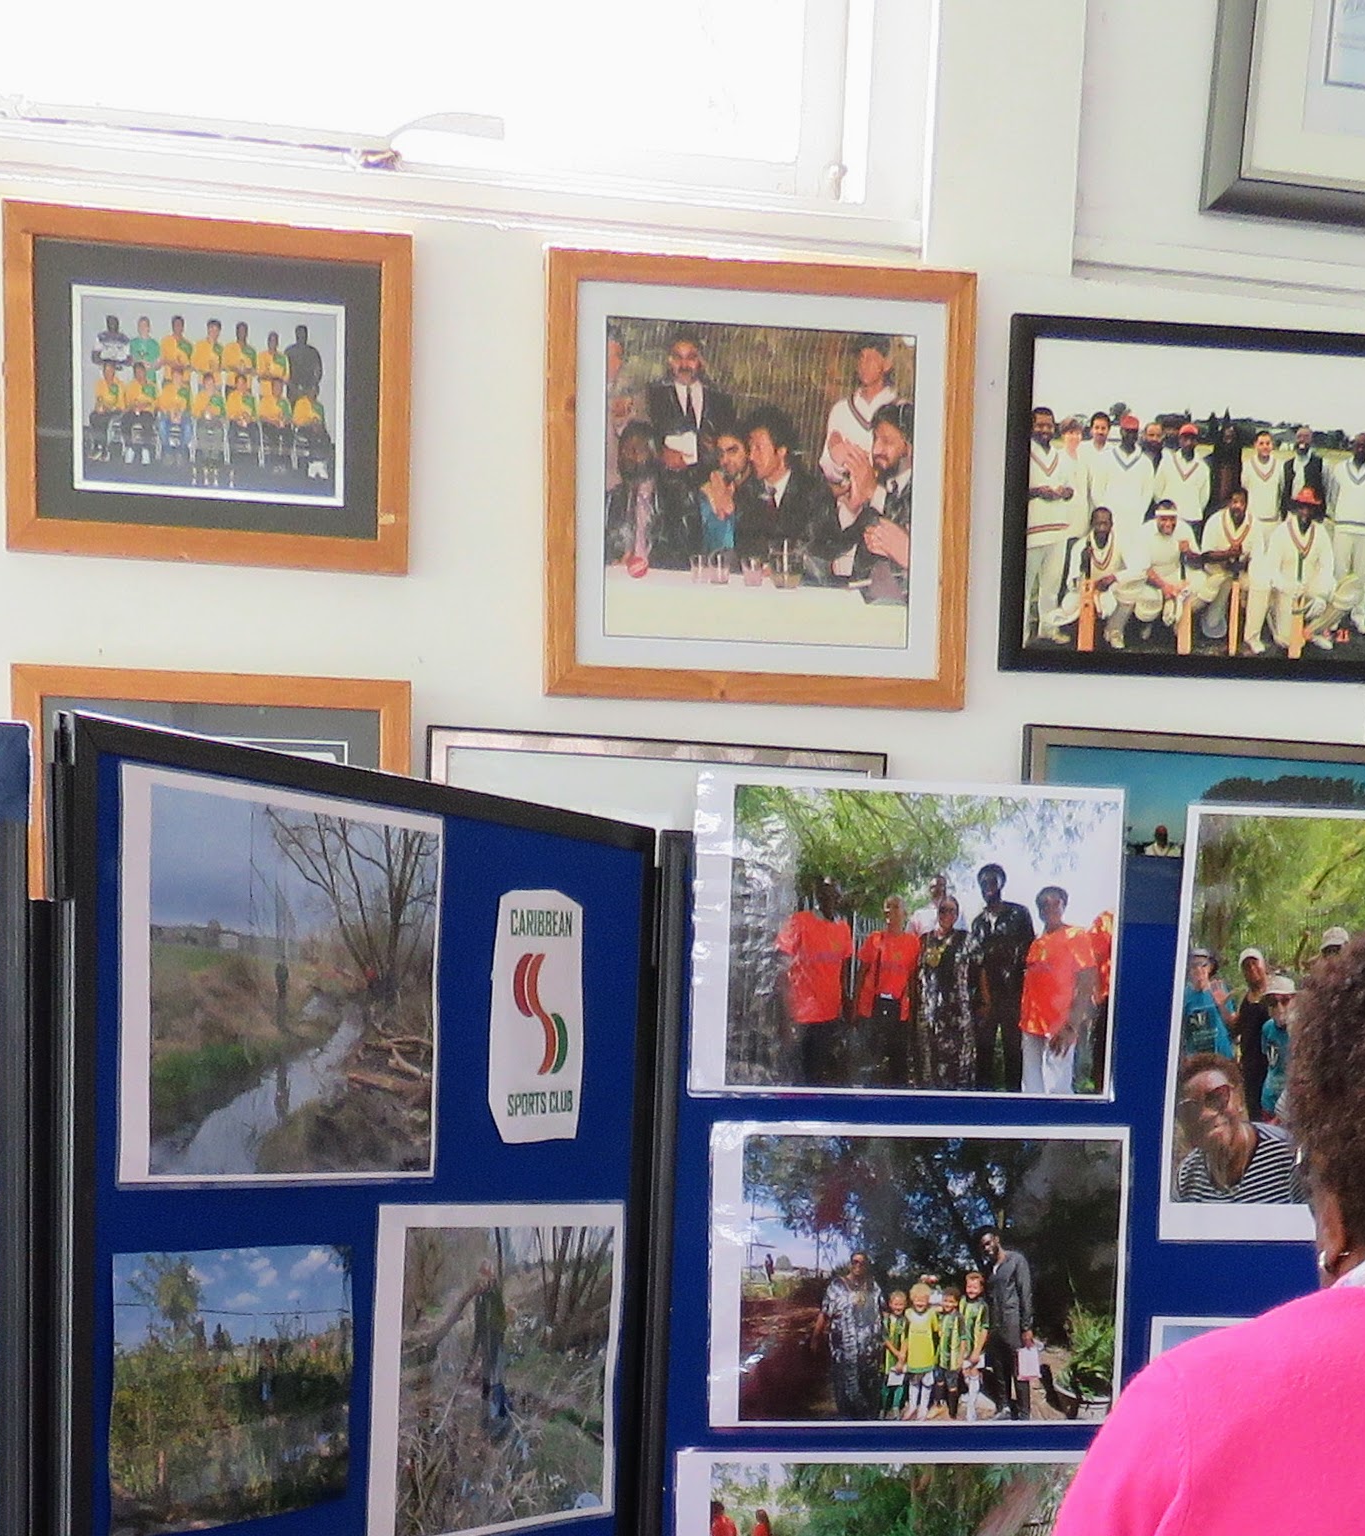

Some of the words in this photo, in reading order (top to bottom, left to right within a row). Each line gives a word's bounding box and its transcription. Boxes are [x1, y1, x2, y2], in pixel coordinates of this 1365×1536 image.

[511, 909, 573, 937] CARIBBEAN
[507, 1091, 547, 1117] SPORTS
[549, 1089, 573, 1114] CLUB
